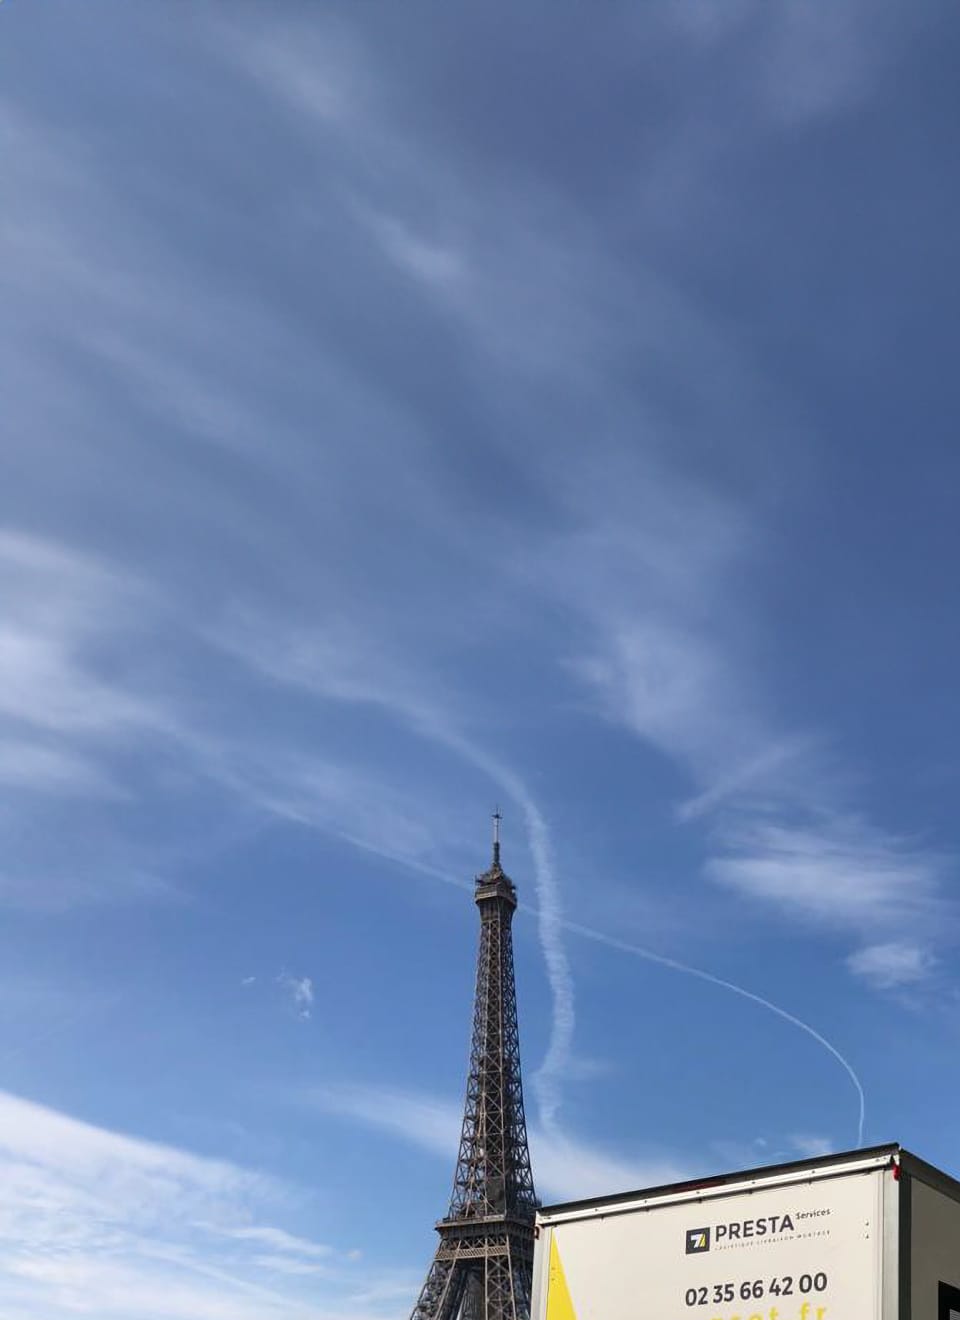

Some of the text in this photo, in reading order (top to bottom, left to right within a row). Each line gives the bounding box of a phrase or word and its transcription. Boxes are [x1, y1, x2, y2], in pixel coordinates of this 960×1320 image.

[715, 1214, 795, 1242] PRESTA
[795, 1208, 831, 1220] Services
[685, 1272, 827, 1306] 02 35 66 42 00
